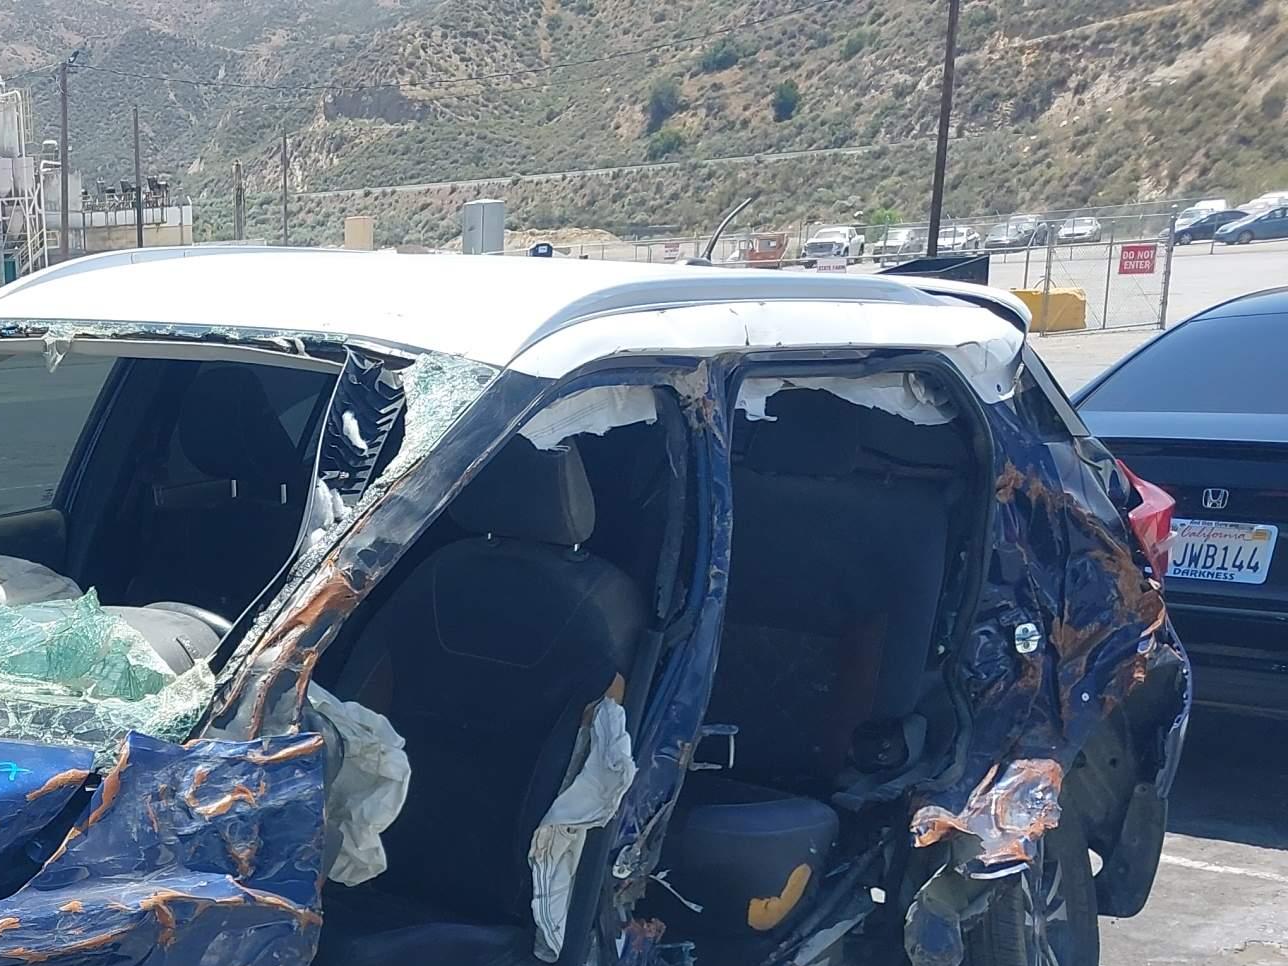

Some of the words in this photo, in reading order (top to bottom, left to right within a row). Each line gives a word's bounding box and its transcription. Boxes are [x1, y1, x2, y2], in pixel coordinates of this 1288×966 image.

[1122, 250, 1135, 260] DO
[1137, 249, 1155, 260] NOT
[1123, 260, 1151, 269] ENTER
[1181, 525, 1246, 542] California
[1172, 543, 1260, 573] JWB144
[1173, 568, 1236, 580] DARKNESS
